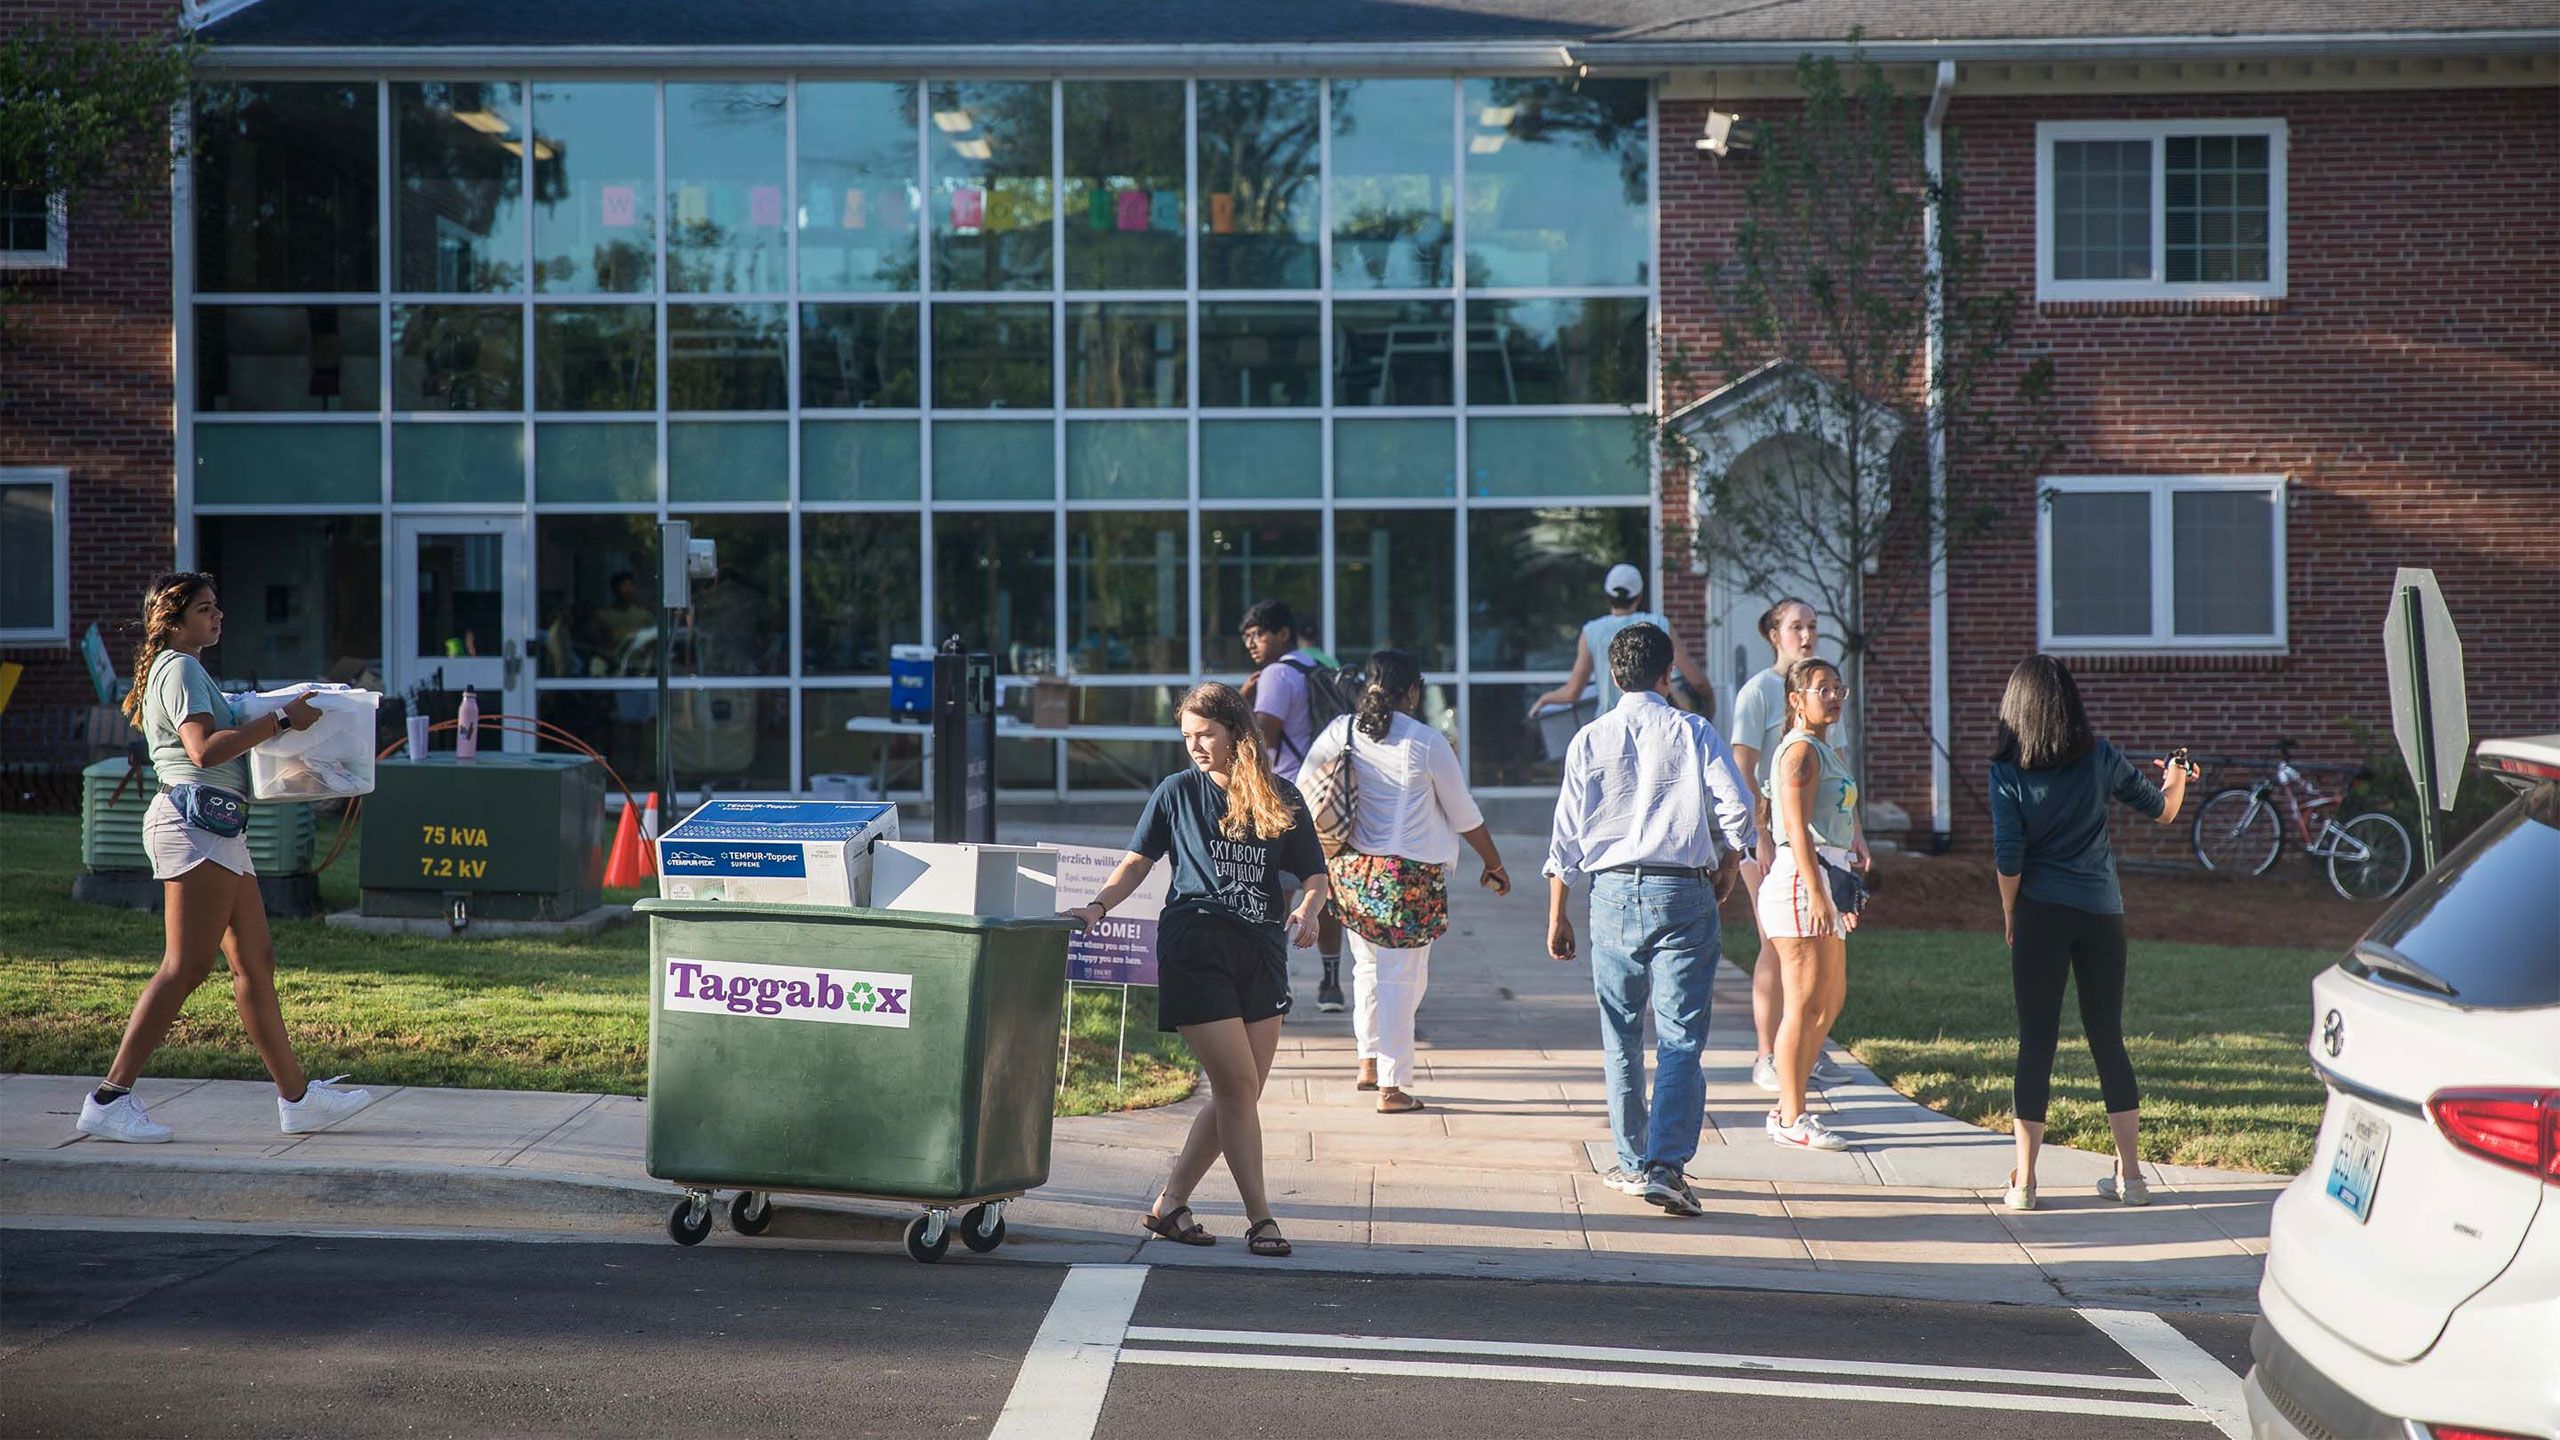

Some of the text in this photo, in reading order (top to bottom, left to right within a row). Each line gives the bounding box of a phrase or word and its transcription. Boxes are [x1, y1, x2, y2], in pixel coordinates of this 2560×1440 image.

[423, 826, 488, 847] 75 kVA
[729, 851, 798, 862] TEMPUR-Topper
[1210, 840, 1266, 865] SKY ABOVE
[421, 858, 487, 879] 7.2 kV
[1237, 863, 1264, 882] BELOW
[1075, 921, 1141, 939] COME!
[1105, 943, 1118, 951] you
[1078, 952, 1098, 964] happy
[1099, 956, 1112, 964] you
